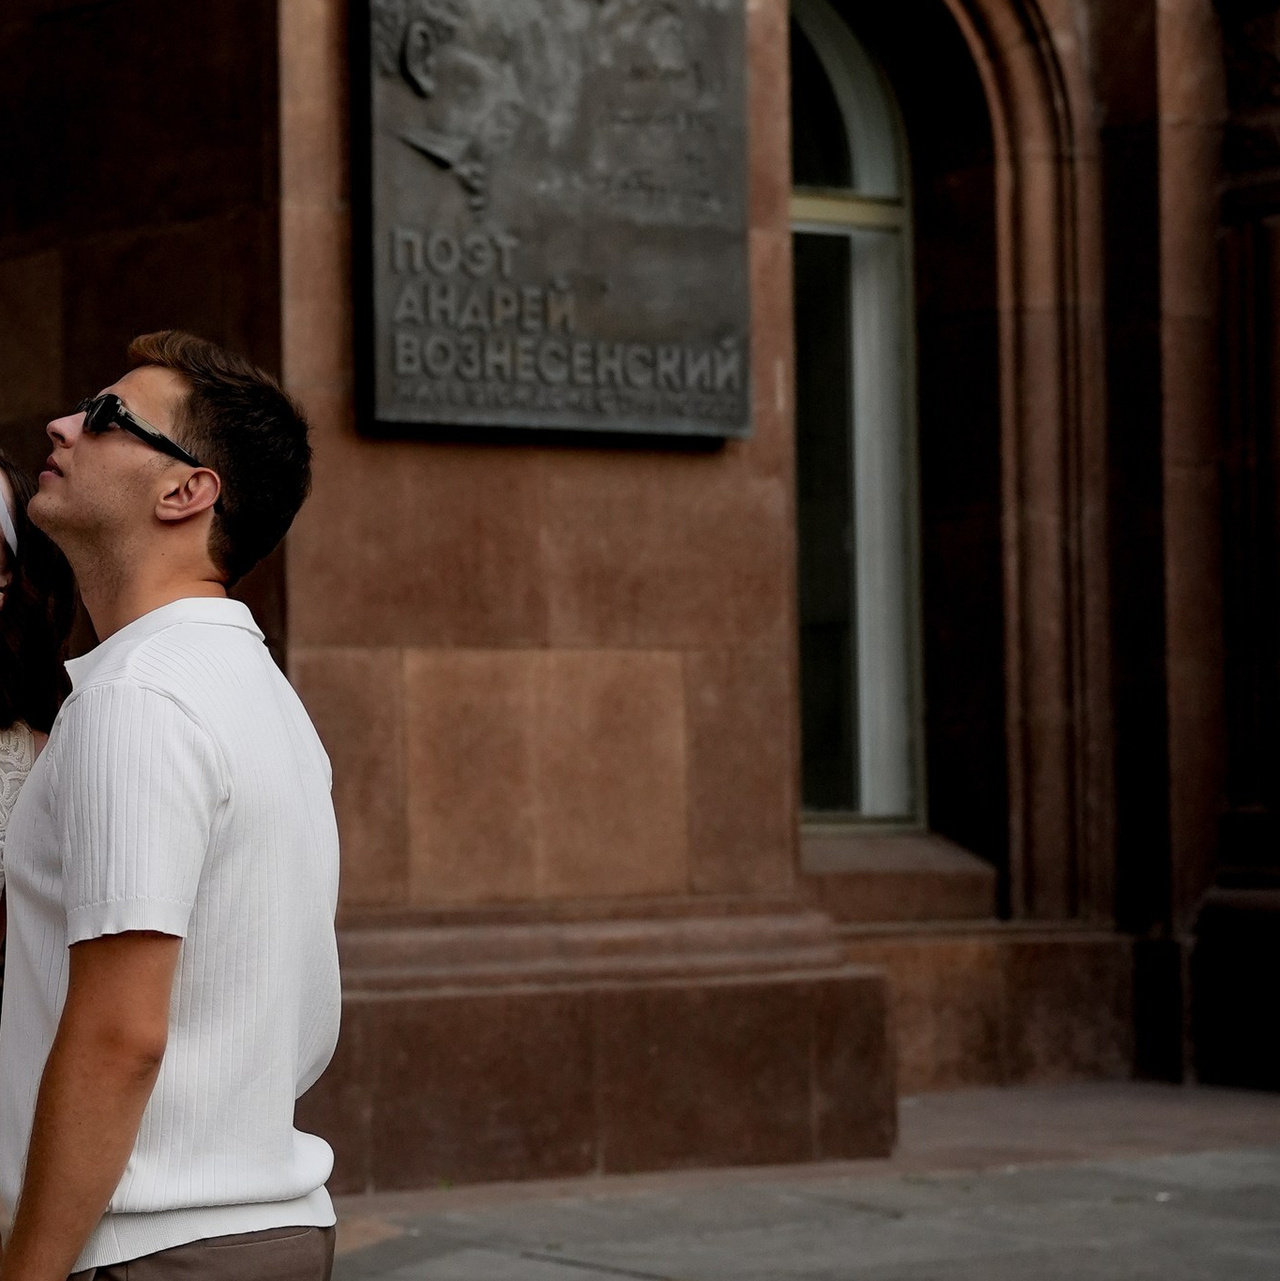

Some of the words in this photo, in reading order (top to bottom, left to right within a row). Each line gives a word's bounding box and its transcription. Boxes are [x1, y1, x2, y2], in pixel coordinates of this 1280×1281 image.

[393, 227, 519, 276] ПОЭТ
[394, 276, 576, 334] АНДРЕЙ
[394, 331, 742, 392] ВОЗНЕСЕНСКИЙ
